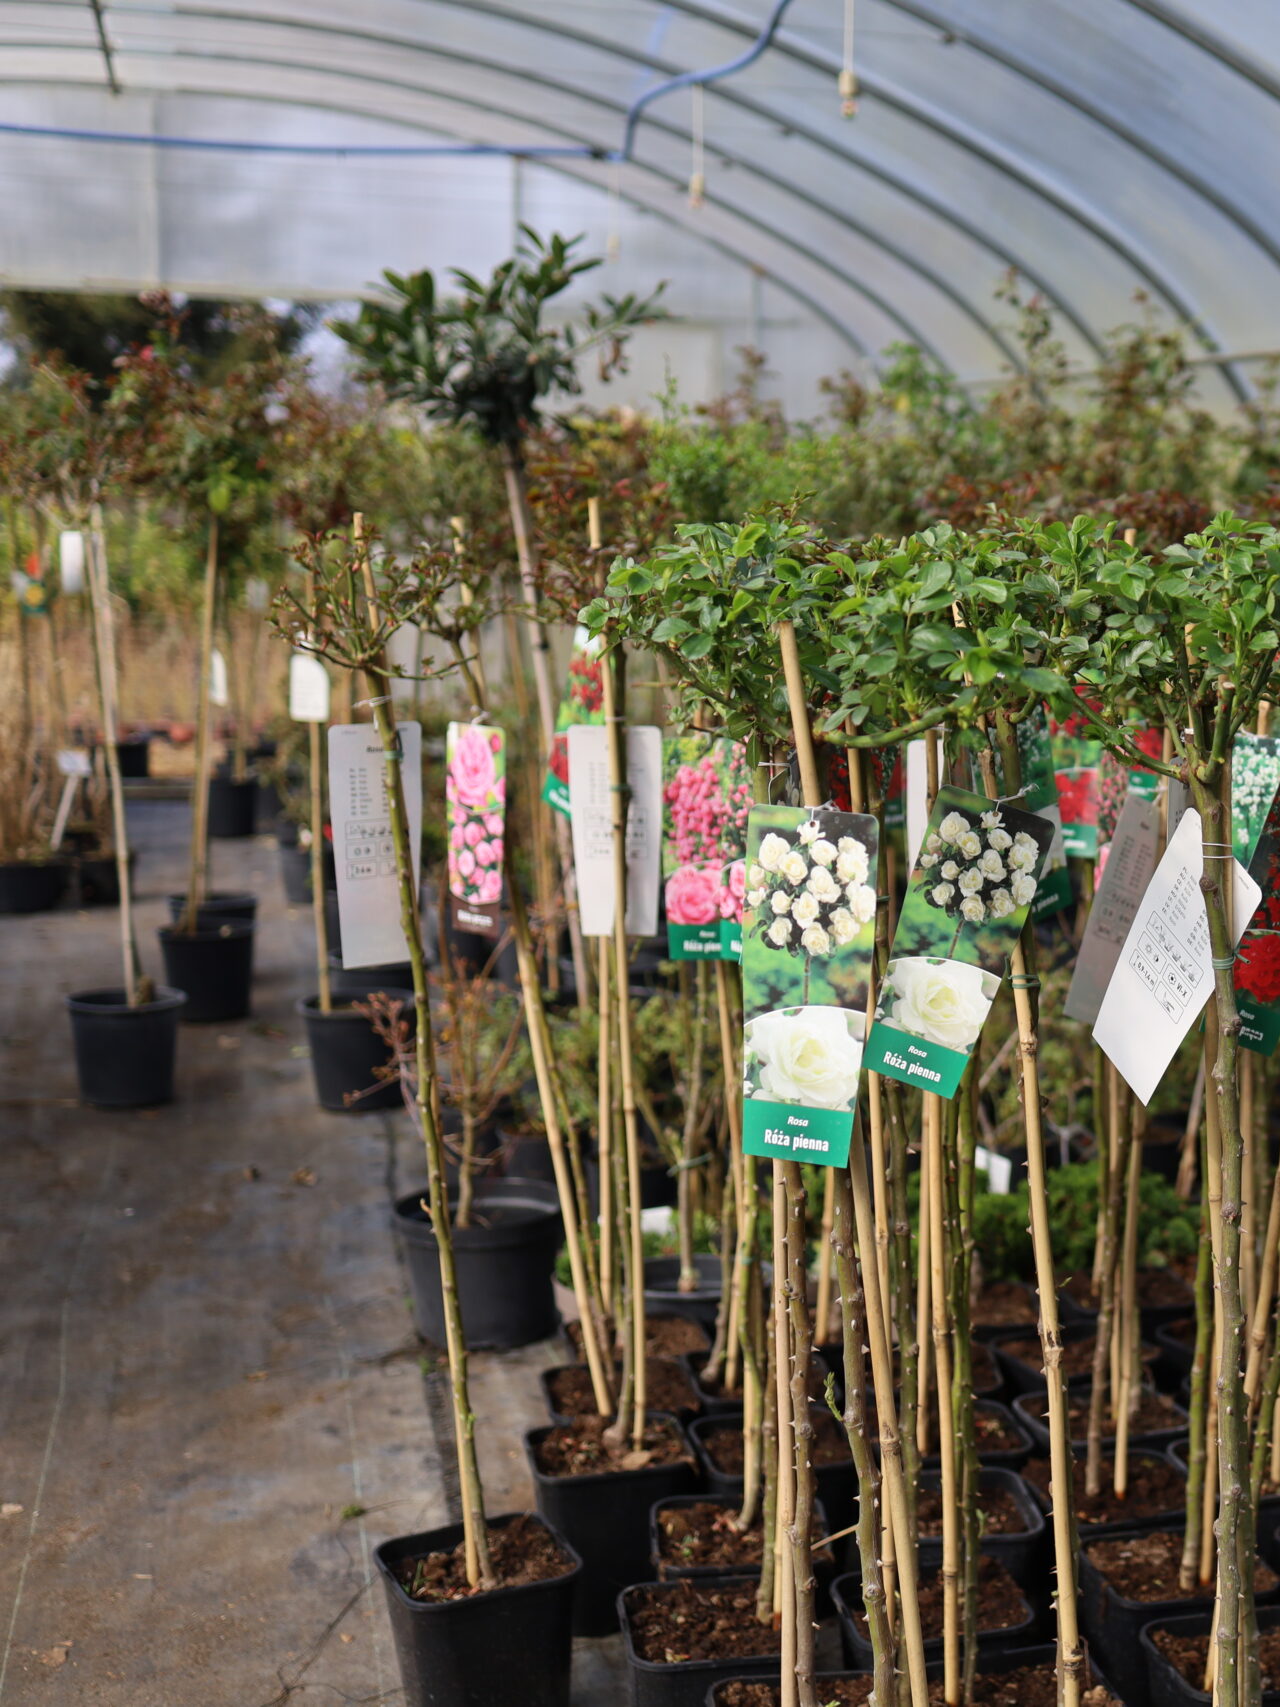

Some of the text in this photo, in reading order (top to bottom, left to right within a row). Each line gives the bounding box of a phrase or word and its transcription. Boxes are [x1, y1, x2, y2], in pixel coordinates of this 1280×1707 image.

[908, 1045, 928, 1058] Rosa
[883, 1051, 942, 1083] Róża pienna
[787, 1115, 809, 1127] Rosa
[764, 1128, 830, 1152] Róża pienna
